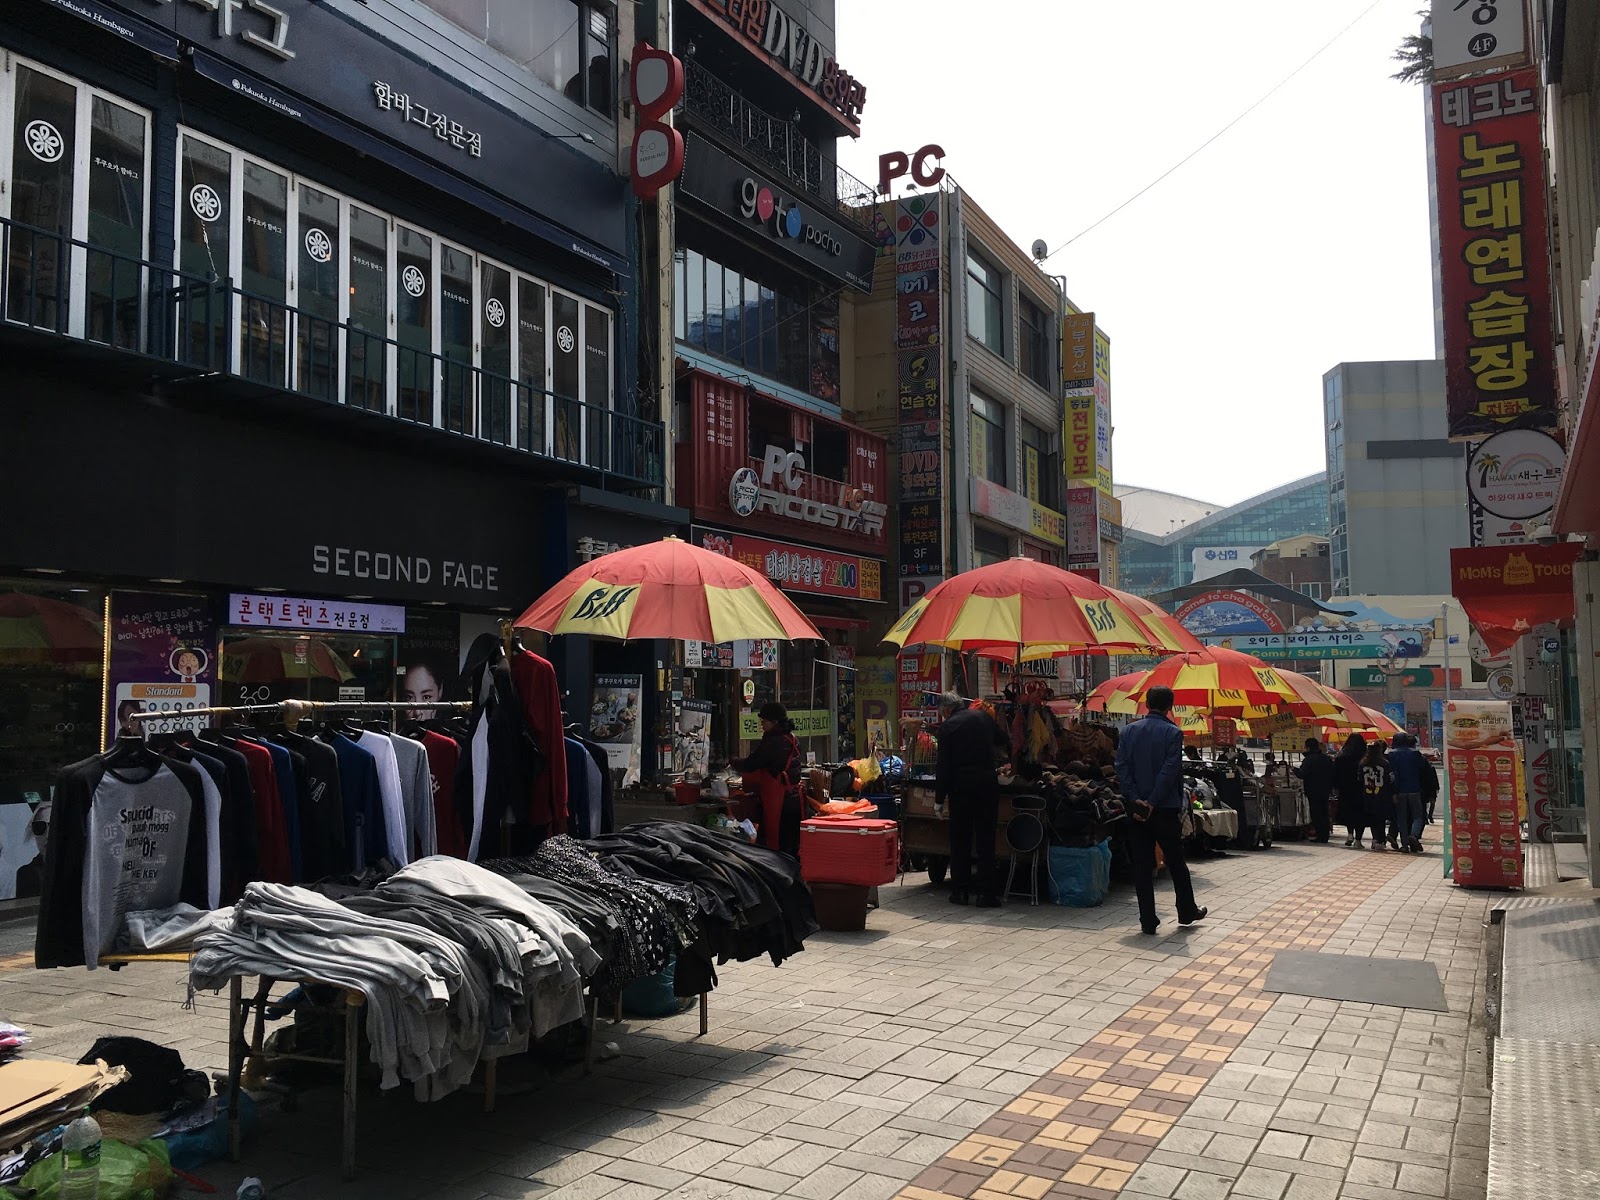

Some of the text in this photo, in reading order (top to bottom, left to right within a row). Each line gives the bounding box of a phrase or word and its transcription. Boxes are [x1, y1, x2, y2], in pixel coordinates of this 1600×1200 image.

[1472, 36, 1494, 53] 4F
[1441, 78, 1535, 128] 테크노
[374, 79, 482, 158] 함바그전문점
[879, 143, 946, 194] PC
[804, 223, 842, 257] pocha
[1459, 133, 1536, 393] 노래연습장
[1072, 329, 1087, 374] 부동산
[900, 392, 938, 411] 연습장
[1073, 410, 1089, 474] 전당포
[761, 444, 805, 491] PC
[901, 449, 938, 475] DVD
[739, 485, 755, 493] RICO
[927, 487, 937, 497] 4F
[1488, 490, 1553, 502] 하와이새우트럭
[757, 487, 885, 538] RICOSTAR
[903, 530, 938, 545] 퓨전주점
[913, 548, 928, 559] 3F
[1216, 549, 1238, 561] 신협
[312, 545, 499, 591] SECOND FACE
[765, 549, 824, 588] 대패삼겹살
[824, 559, 858, 590] 2200
[861, 560, 879, 571] 100%
[1534, 563, 1572, 577] TOUC
[902, 580, 926, 607] P
[1207, 593, 1221, 601] to
[238, 596, 371, 630] 콘택트렌즈 전문점
[1328, 633, 1365, 646] 사이소
[1250, 648, 1362, 659] Come! See! Buy!
[145, 685, 183, 697] Standard
[744, 719, 758, 733] 우리는
[142, 869, 159, 879] KEY
